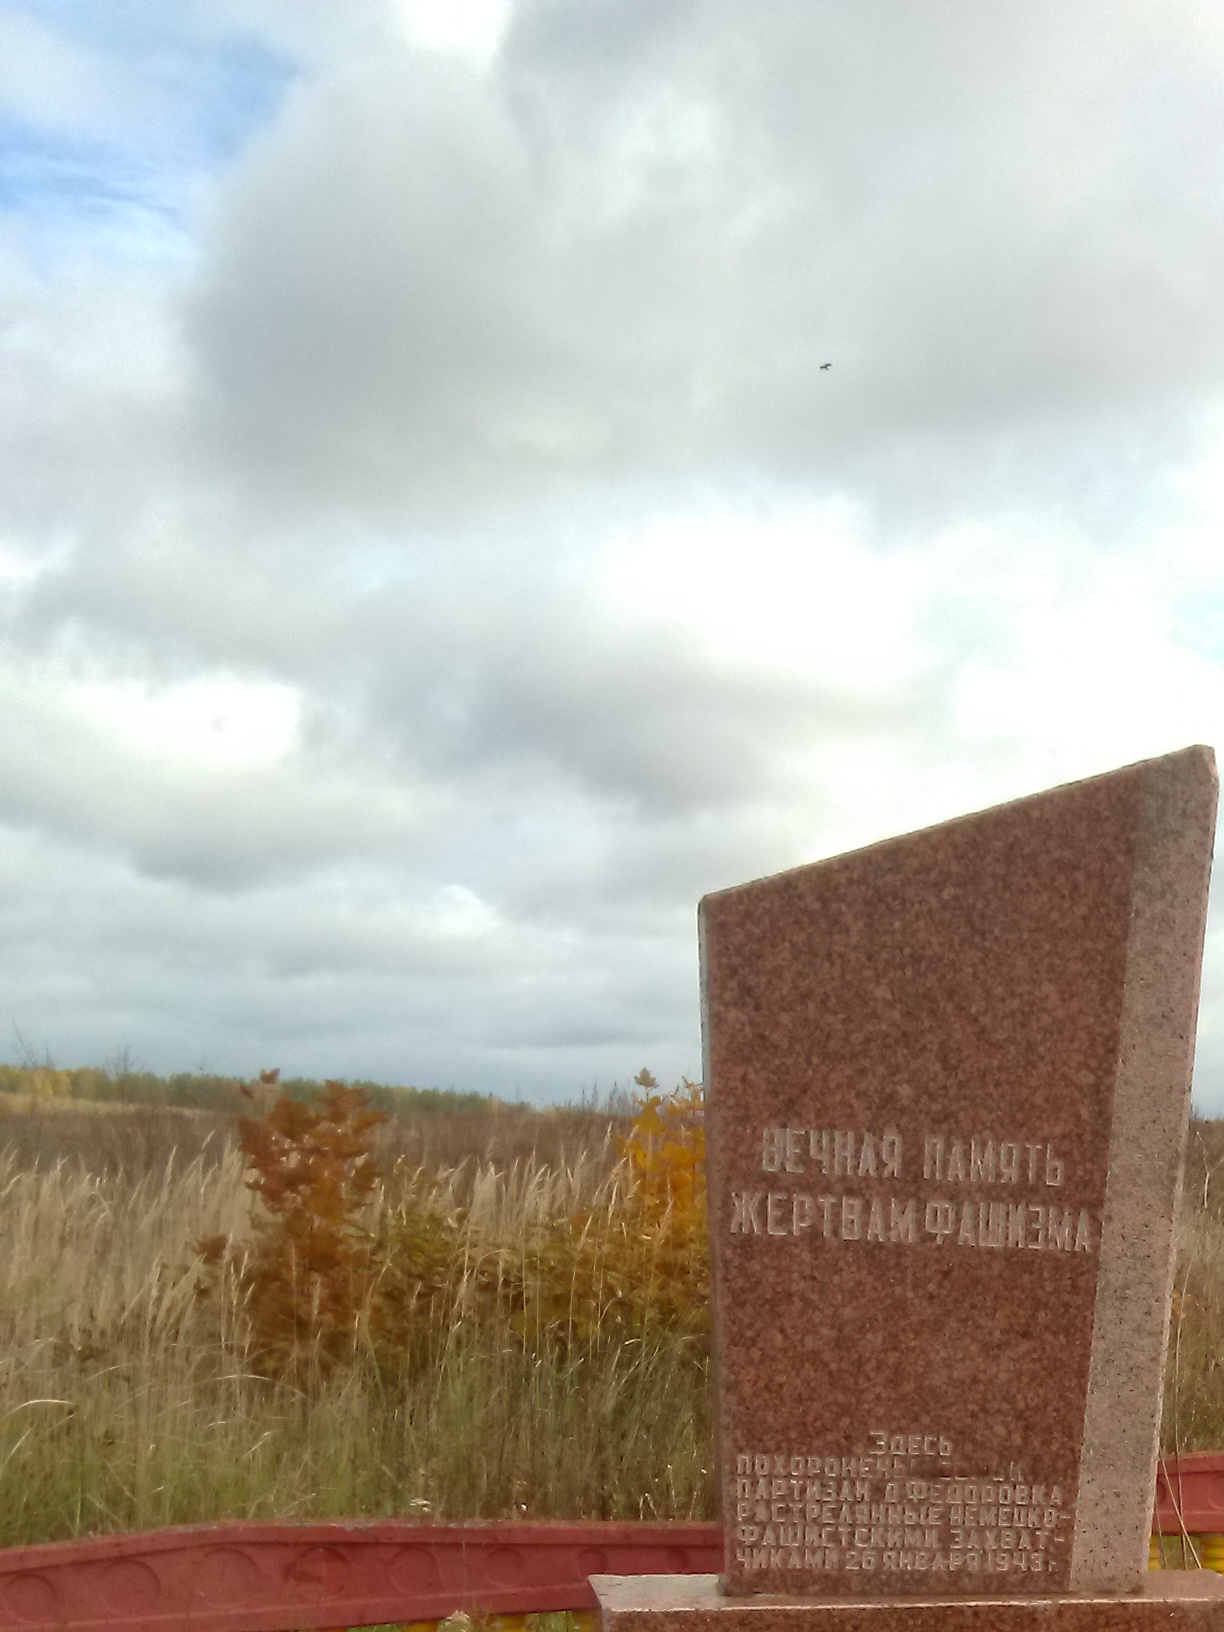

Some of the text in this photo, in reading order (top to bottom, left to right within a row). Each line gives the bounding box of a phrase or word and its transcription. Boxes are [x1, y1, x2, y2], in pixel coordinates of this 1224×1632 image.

[762, 1127, 1065, 1187] ВЕЧНАЯ ПАМЯТЬ
[730, 1191, 1092, 1252] ЖЕРТВАМ ФАШИЗМА
[737, 1478, 871, 1503] ПАРТИЗАН
[950, 1506, 1071, 1528] НЕМЕЦКО-
[736, 1525, 1065, 1550] ФАШИСТСКИМИ ЗАХВАТ-
[737, 1547, 839, 1570] ЧИКАМИ
